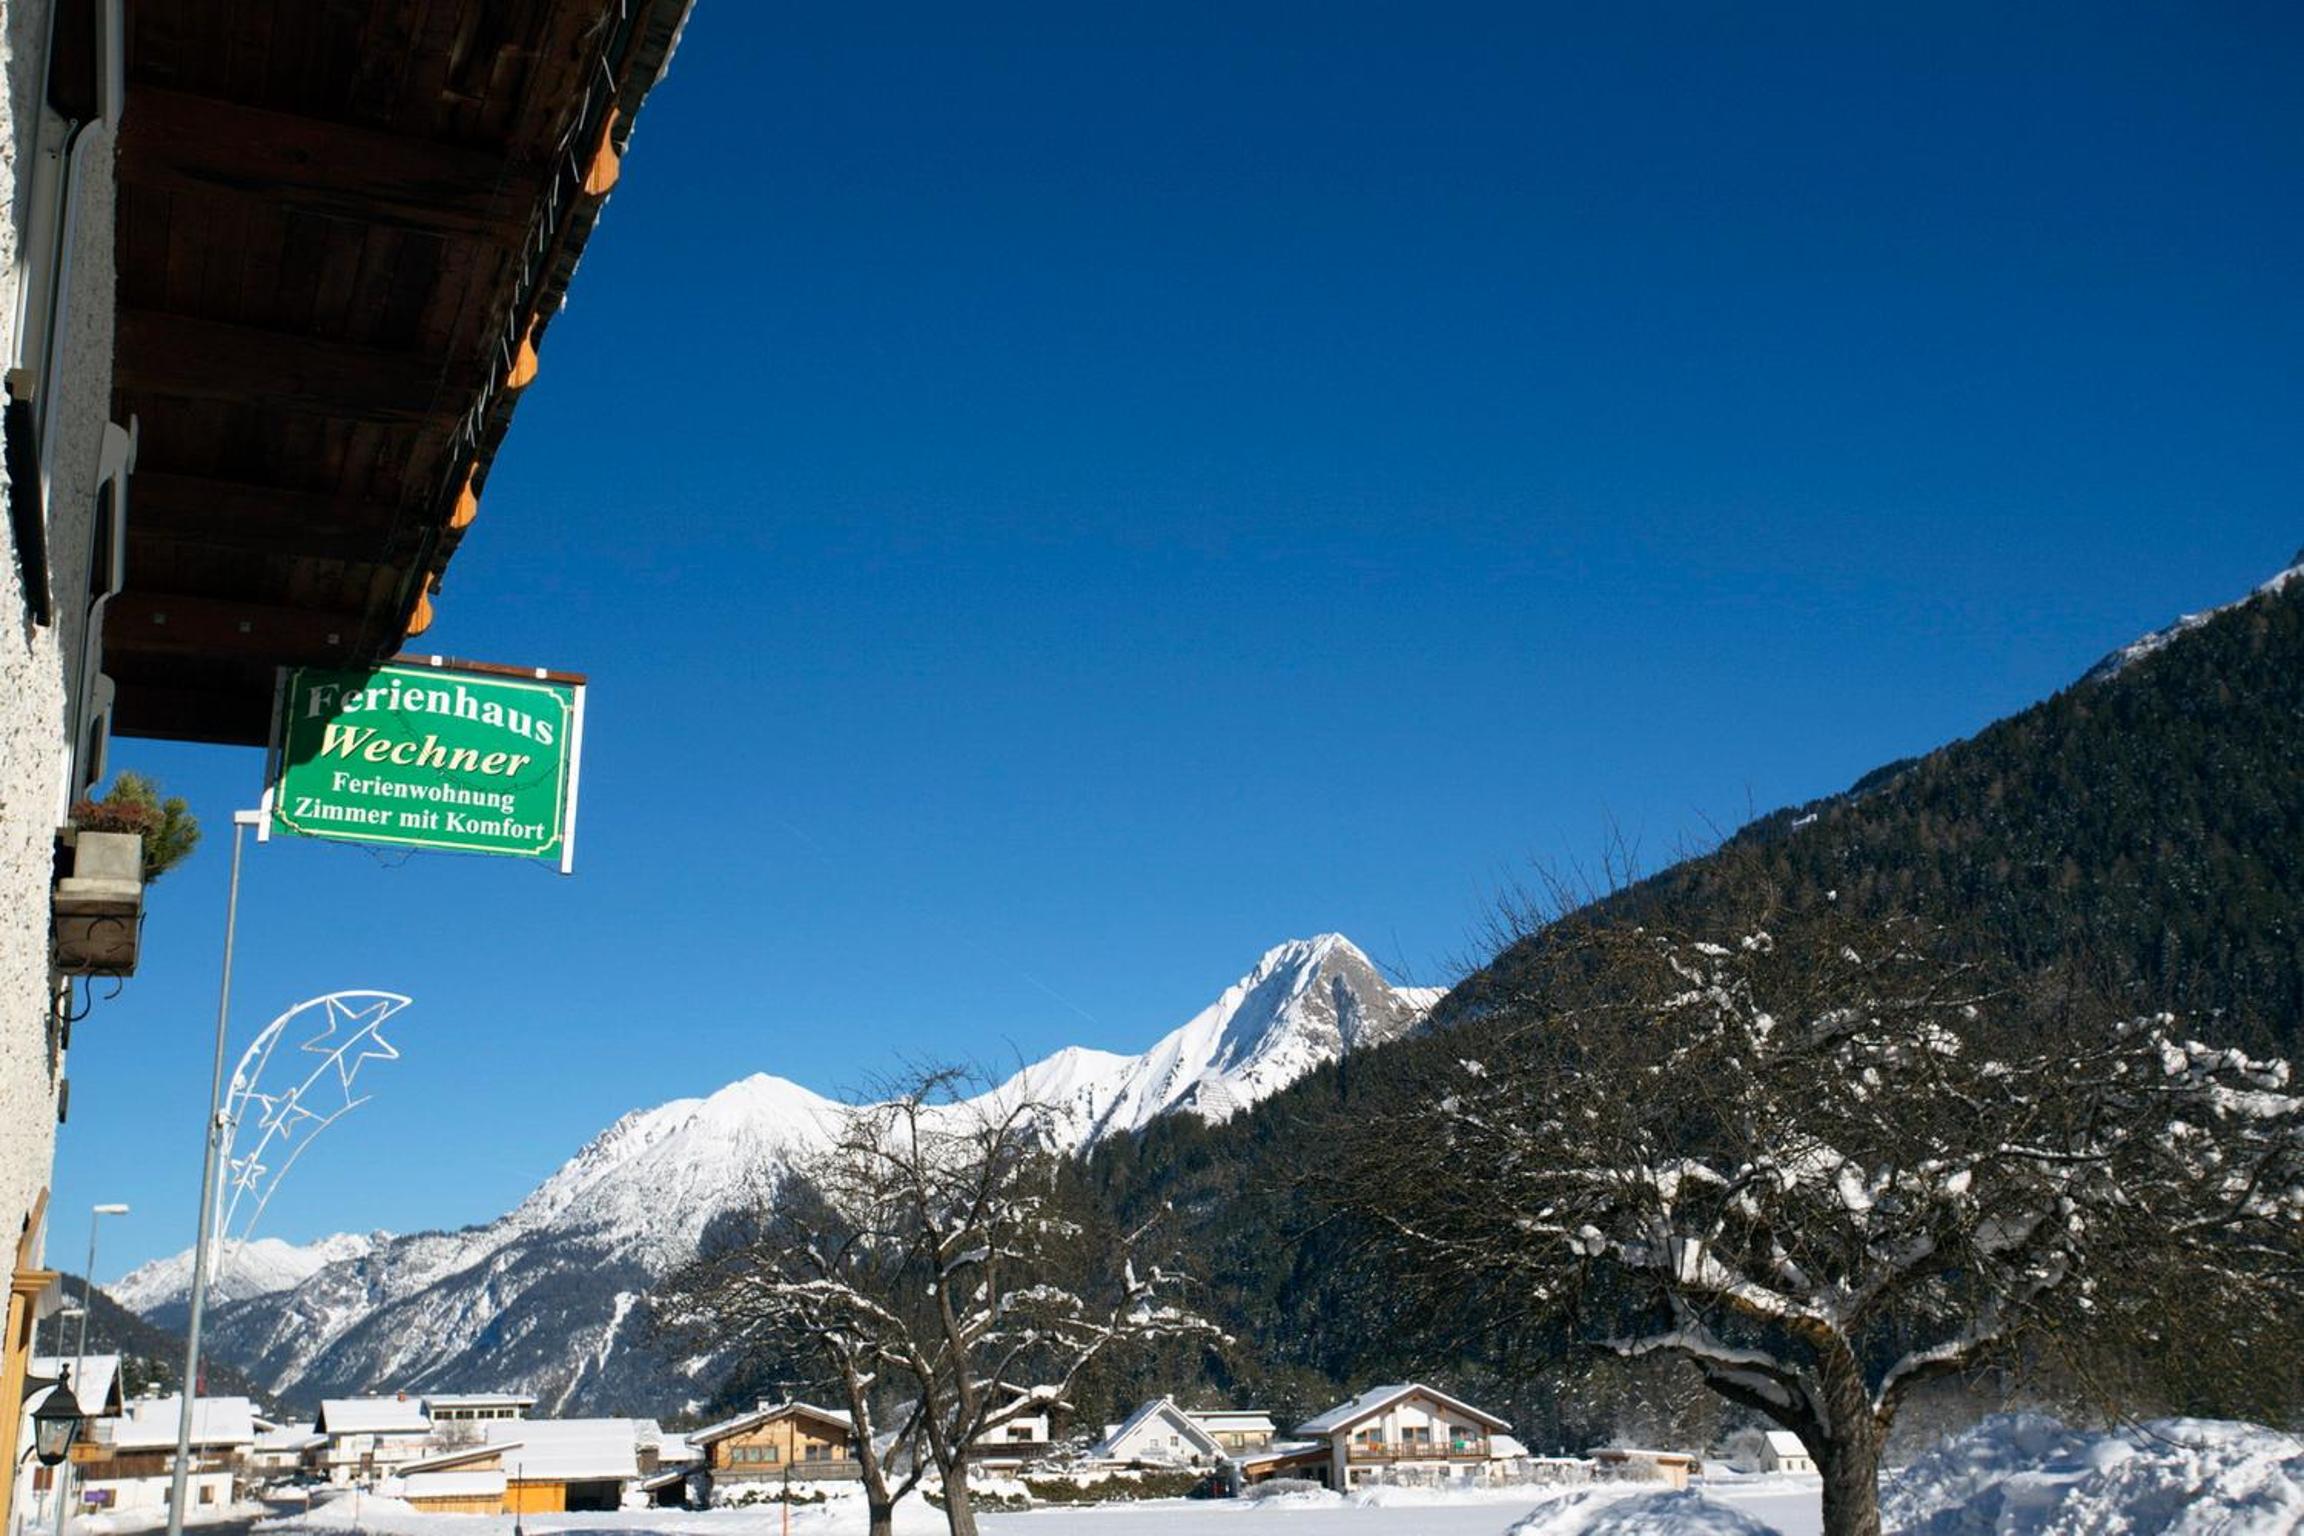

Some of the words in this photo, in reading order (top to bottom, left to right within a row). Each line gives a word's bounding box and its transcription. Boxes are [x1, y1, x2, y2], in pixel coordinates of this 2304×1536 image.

[306, 680, 554, 745] Ferienhaus
[320, 723, 530, 776] Wechner
[332, 771, 515, 813] Ferienwohnung
[294, 797, 392, 826] Zimmer
[399, 809, 438, 831] mit
[445, 812, 545, 841] Komfort
